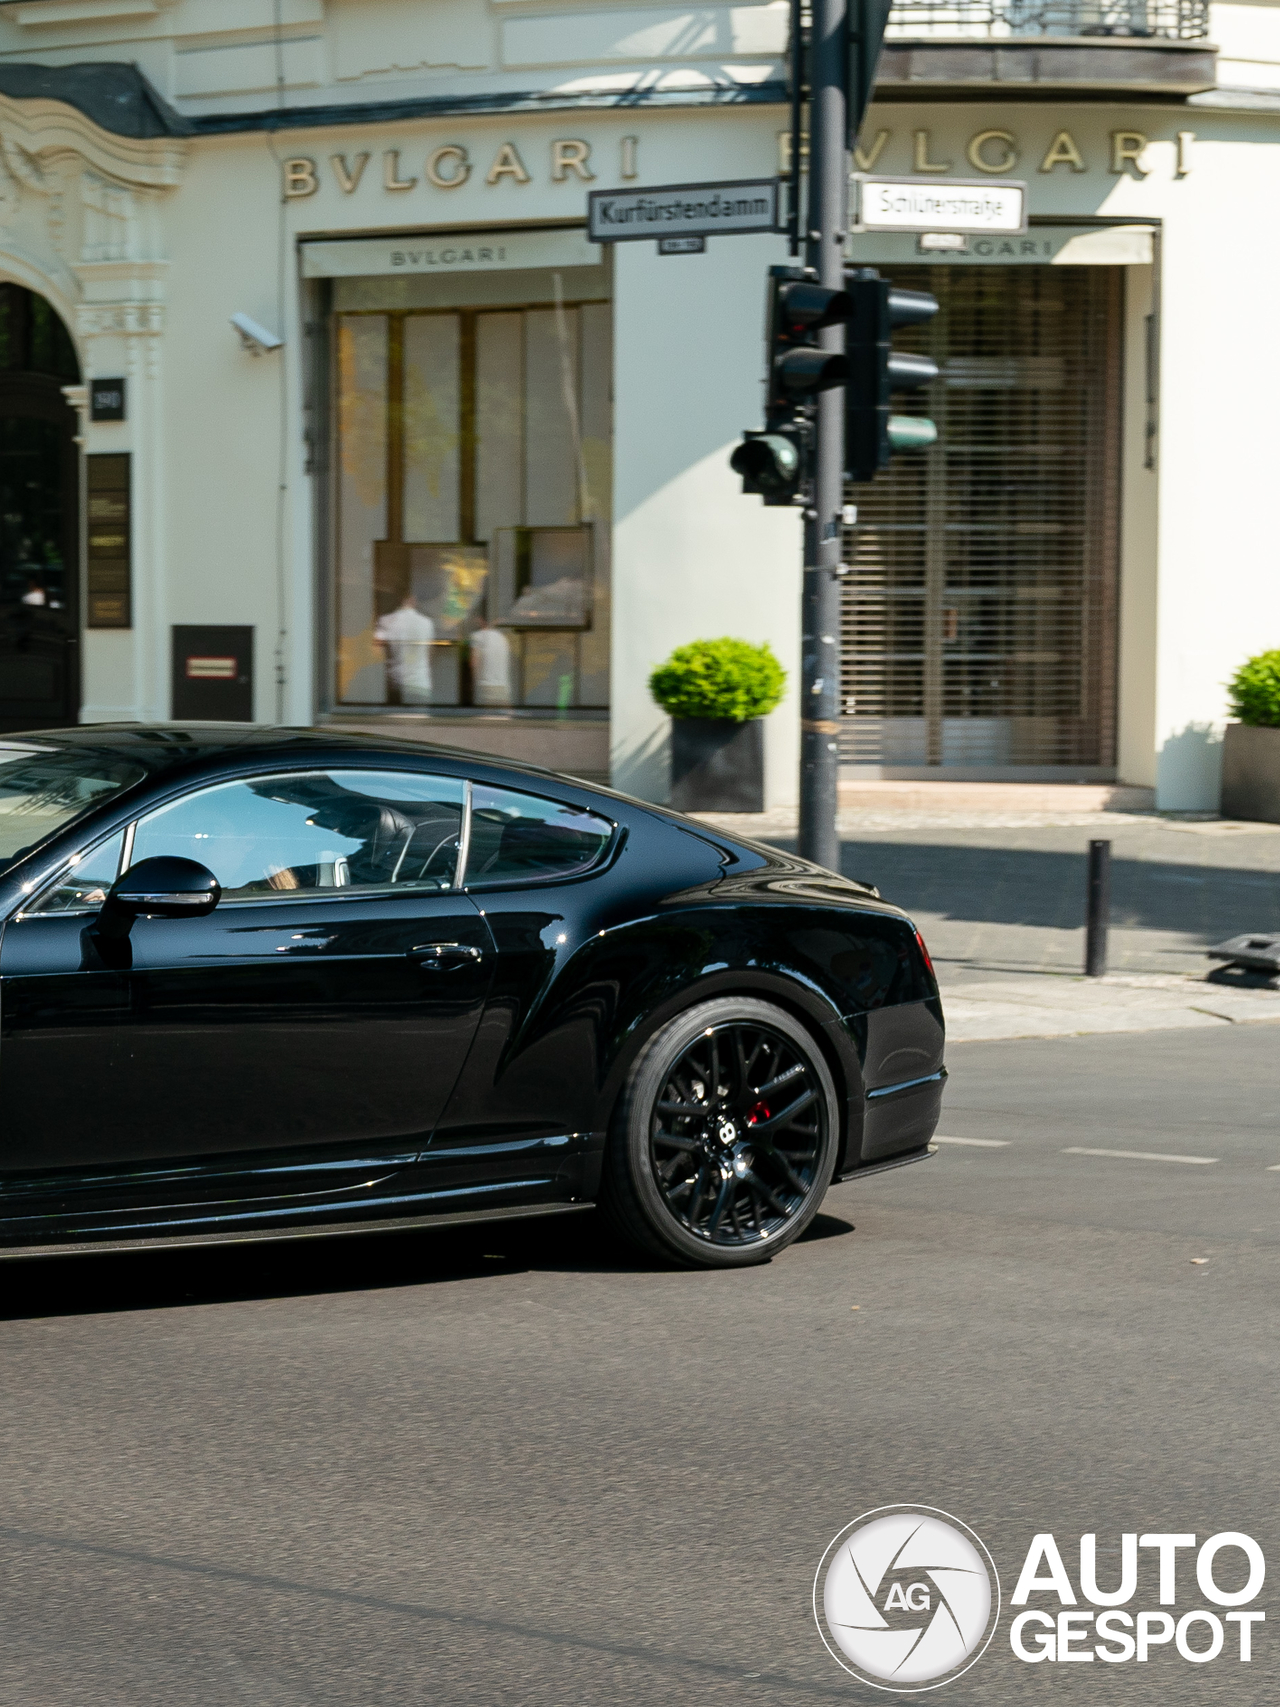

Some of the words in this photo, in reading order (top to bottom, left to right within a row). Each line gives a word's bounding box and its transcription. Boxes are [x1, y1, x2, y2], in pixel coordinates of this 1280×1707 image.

[282, 136, 640, 199] BVLGARI
[599, 194, 769, 224] Kurfürstendamm
[880, 189, 1004, 221] Schlüterstraße
[389, 246, 506, 267] BVLGARI
